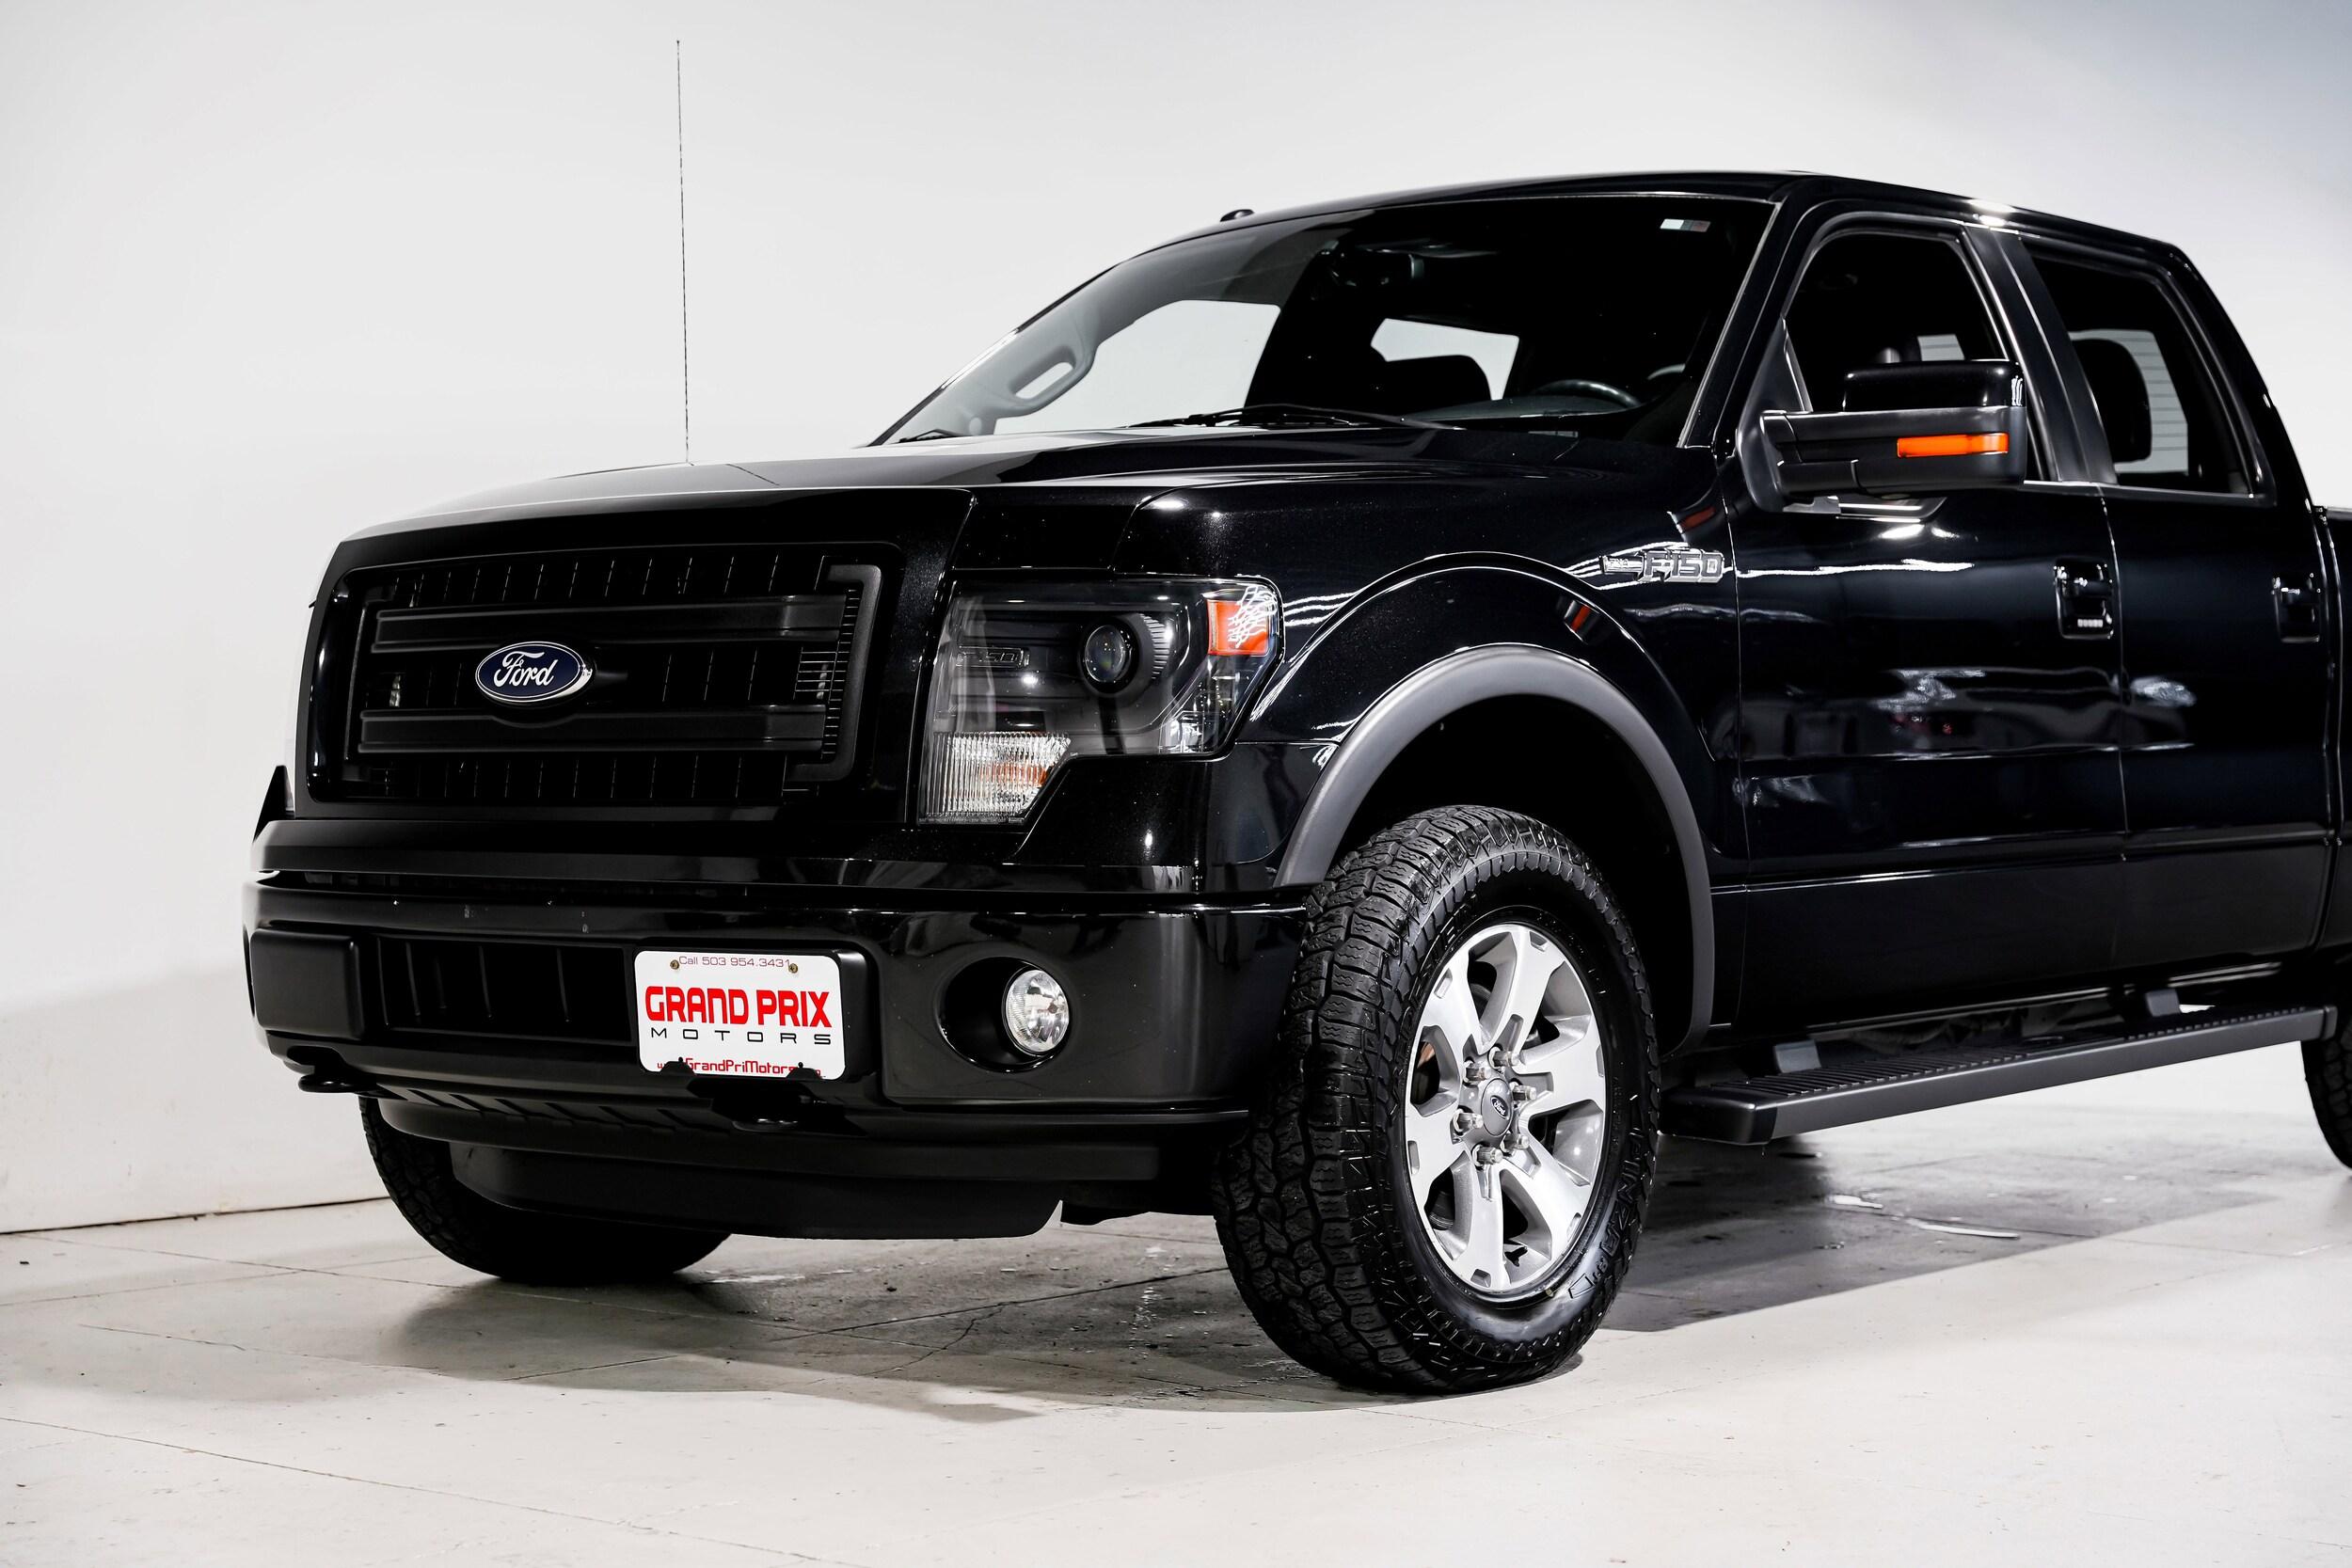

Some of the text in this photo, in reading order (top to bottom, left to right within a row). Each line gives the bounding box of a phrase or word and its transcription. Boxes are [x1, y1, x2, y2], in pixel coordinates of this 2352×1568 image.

[493, 651, 559, 688] Ford
[678, 956, 790, 968] Call 503 954.3431
[644, 985, 833, 1028] GRAND PRIX
[651, 1027, 832, 1045] MOTORS
